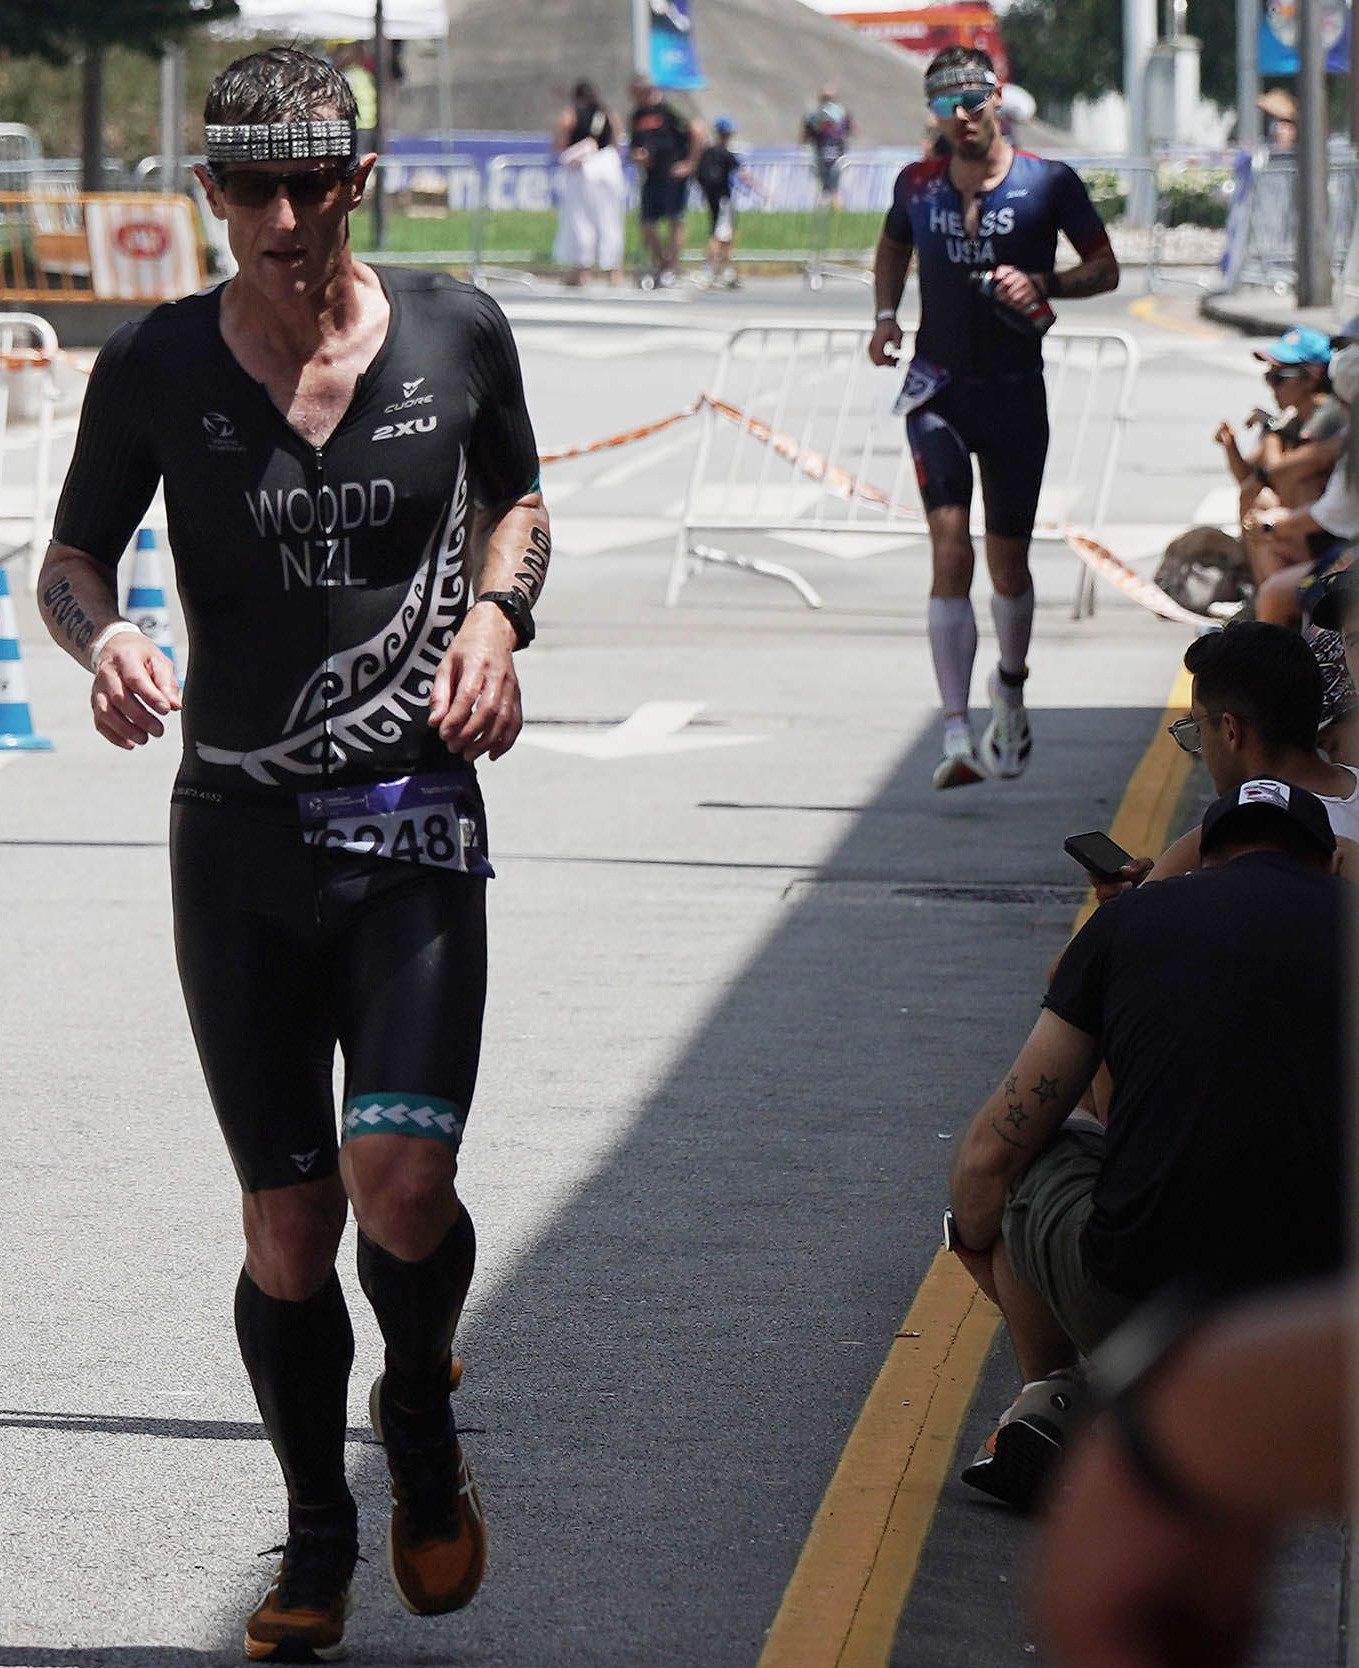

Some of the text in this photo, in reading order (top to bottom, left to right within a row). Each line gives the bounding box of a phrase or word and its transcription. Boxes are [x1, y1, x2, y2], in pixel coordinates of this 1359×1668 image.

[946, 238, 997, 264] USA
[384, 394, 434, 413] CUORE
[371, 415, 437, 441] 2XU
[243, 478, 396, 537] WOODD
[279, 537, 368, 591] NZL
